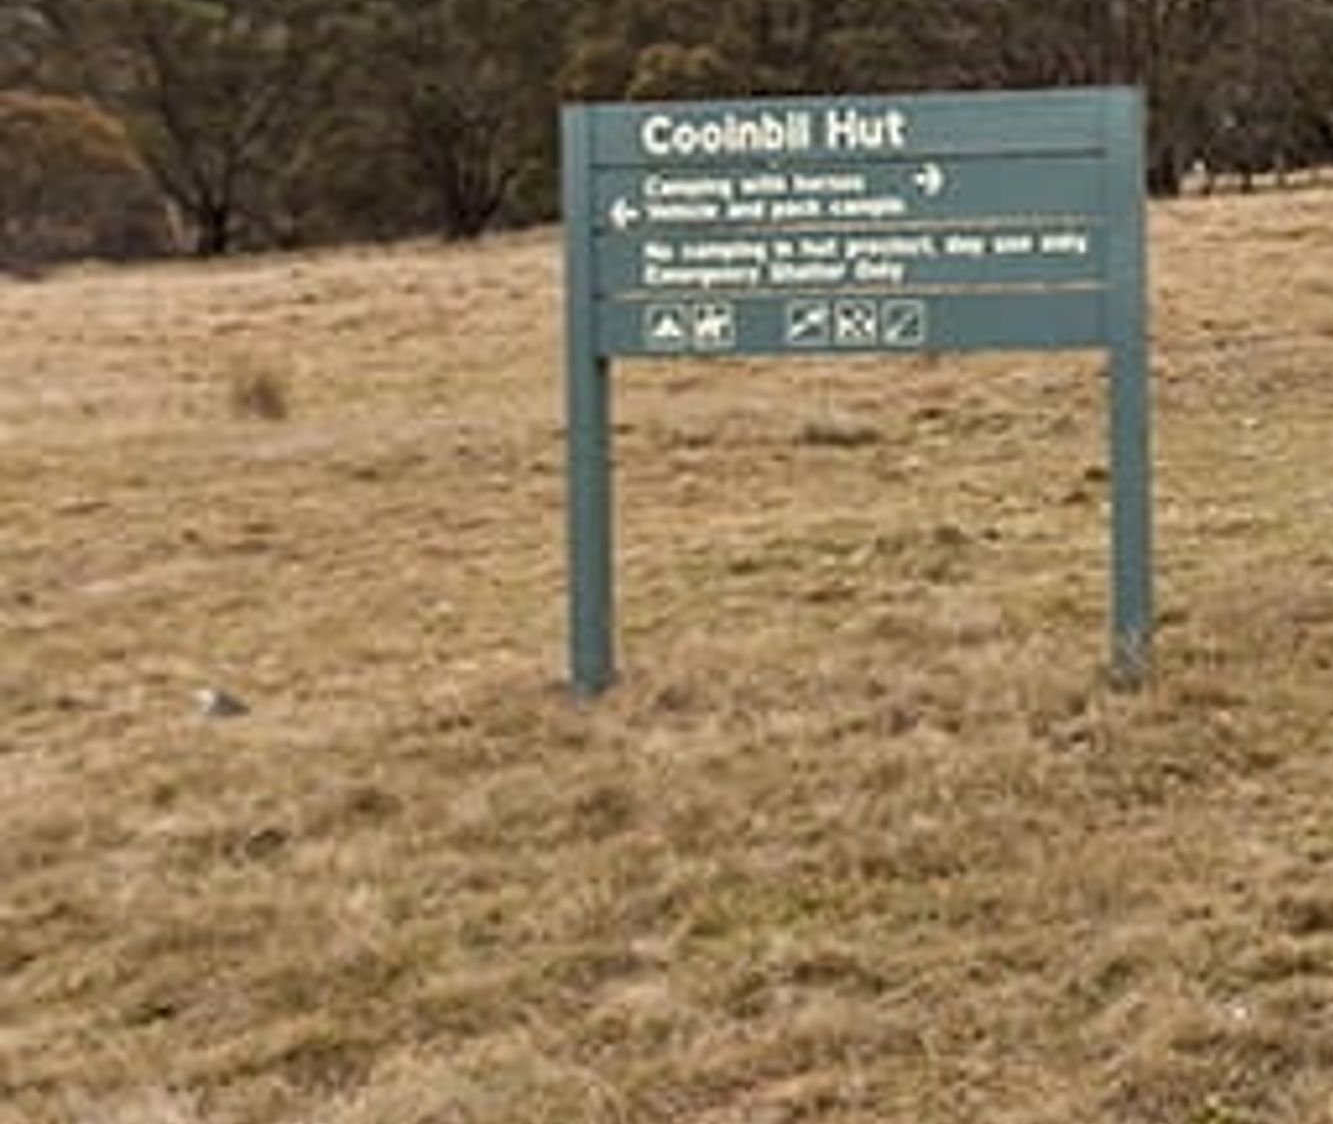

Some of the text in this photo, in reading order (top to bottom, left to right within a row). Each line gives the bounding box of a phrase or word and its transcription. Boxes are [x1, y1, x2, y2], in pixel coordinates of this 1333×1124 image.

[642, 109, 905, 154] Cooinbil Hut
[728, 198, 763, 219] and
[645, 241, 674, 262] No
